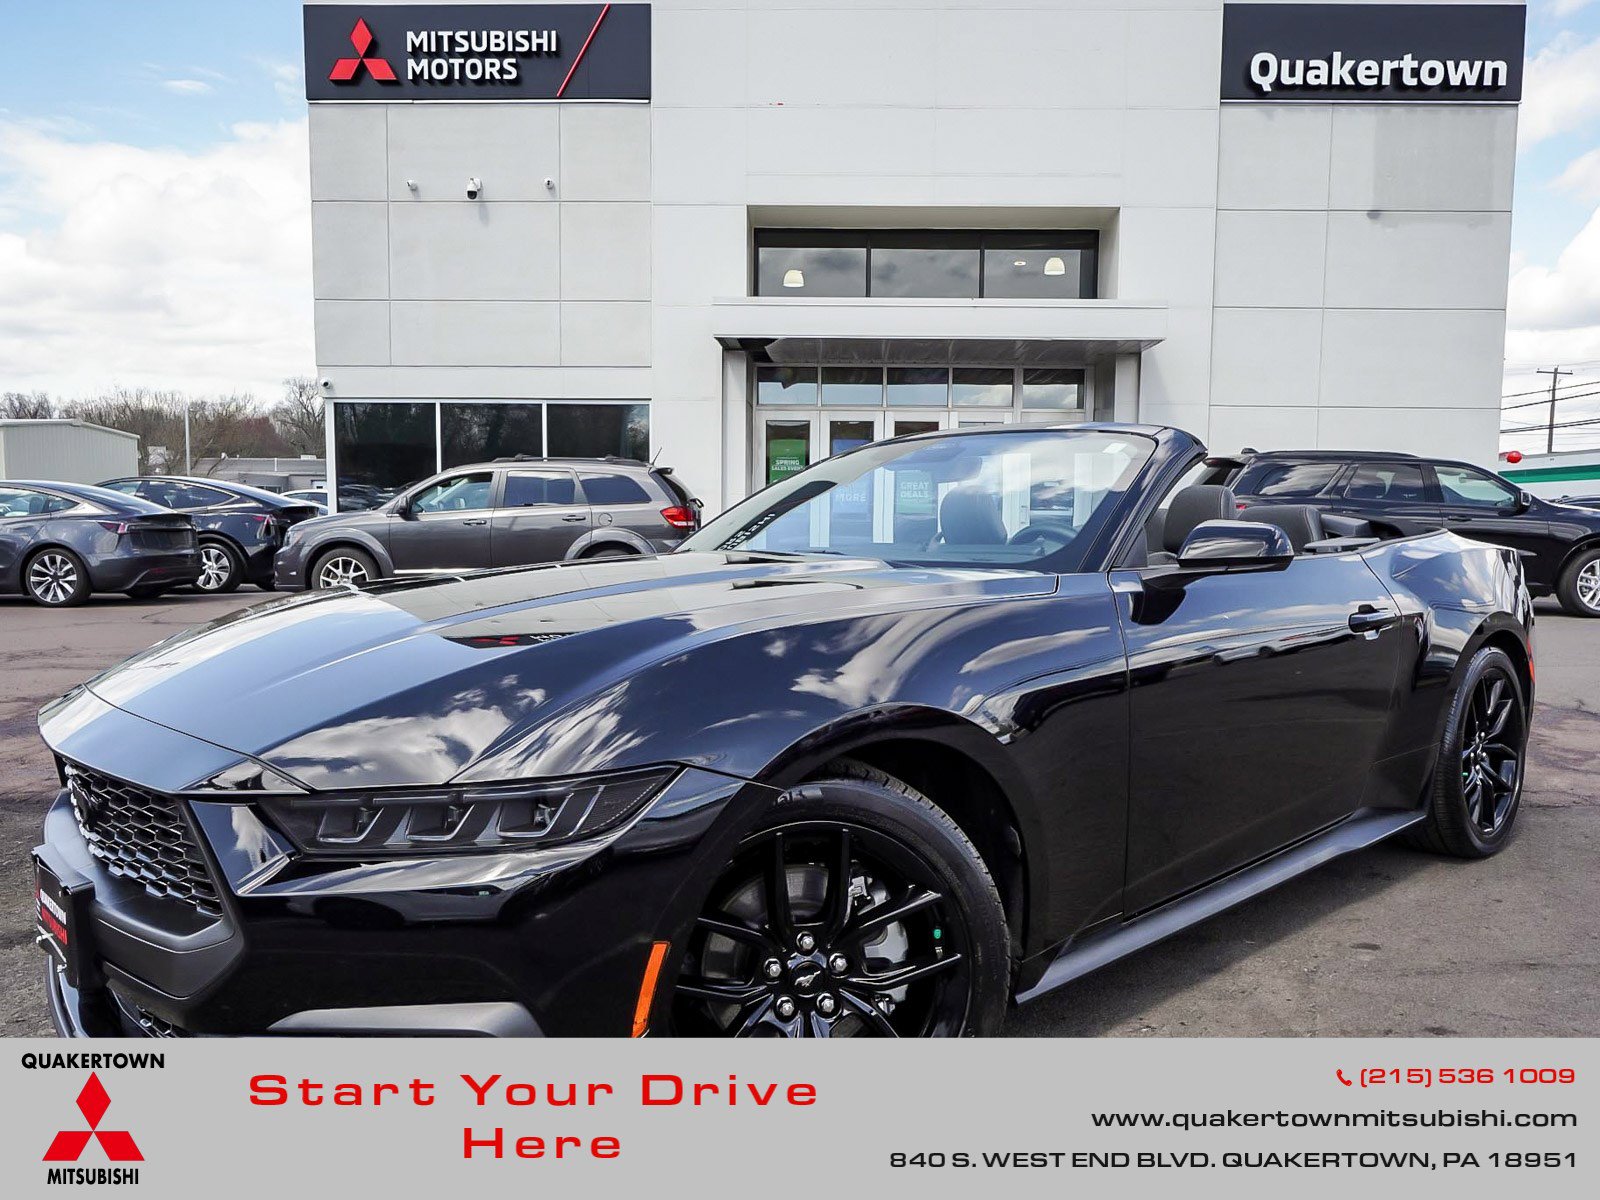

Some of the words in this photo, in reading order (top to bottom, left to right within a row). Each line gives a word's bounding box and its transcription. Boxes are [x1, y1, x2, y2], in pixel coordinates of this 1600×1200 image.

[406, 30, 557, 53] MITSUBISHI
[406, 58, 518, 80] MOTORS
[1250, 51, 1508, 92] Quakertown
[900, 482, 930, 491] GREAT
[900, 491, 929, 499] DEALS
